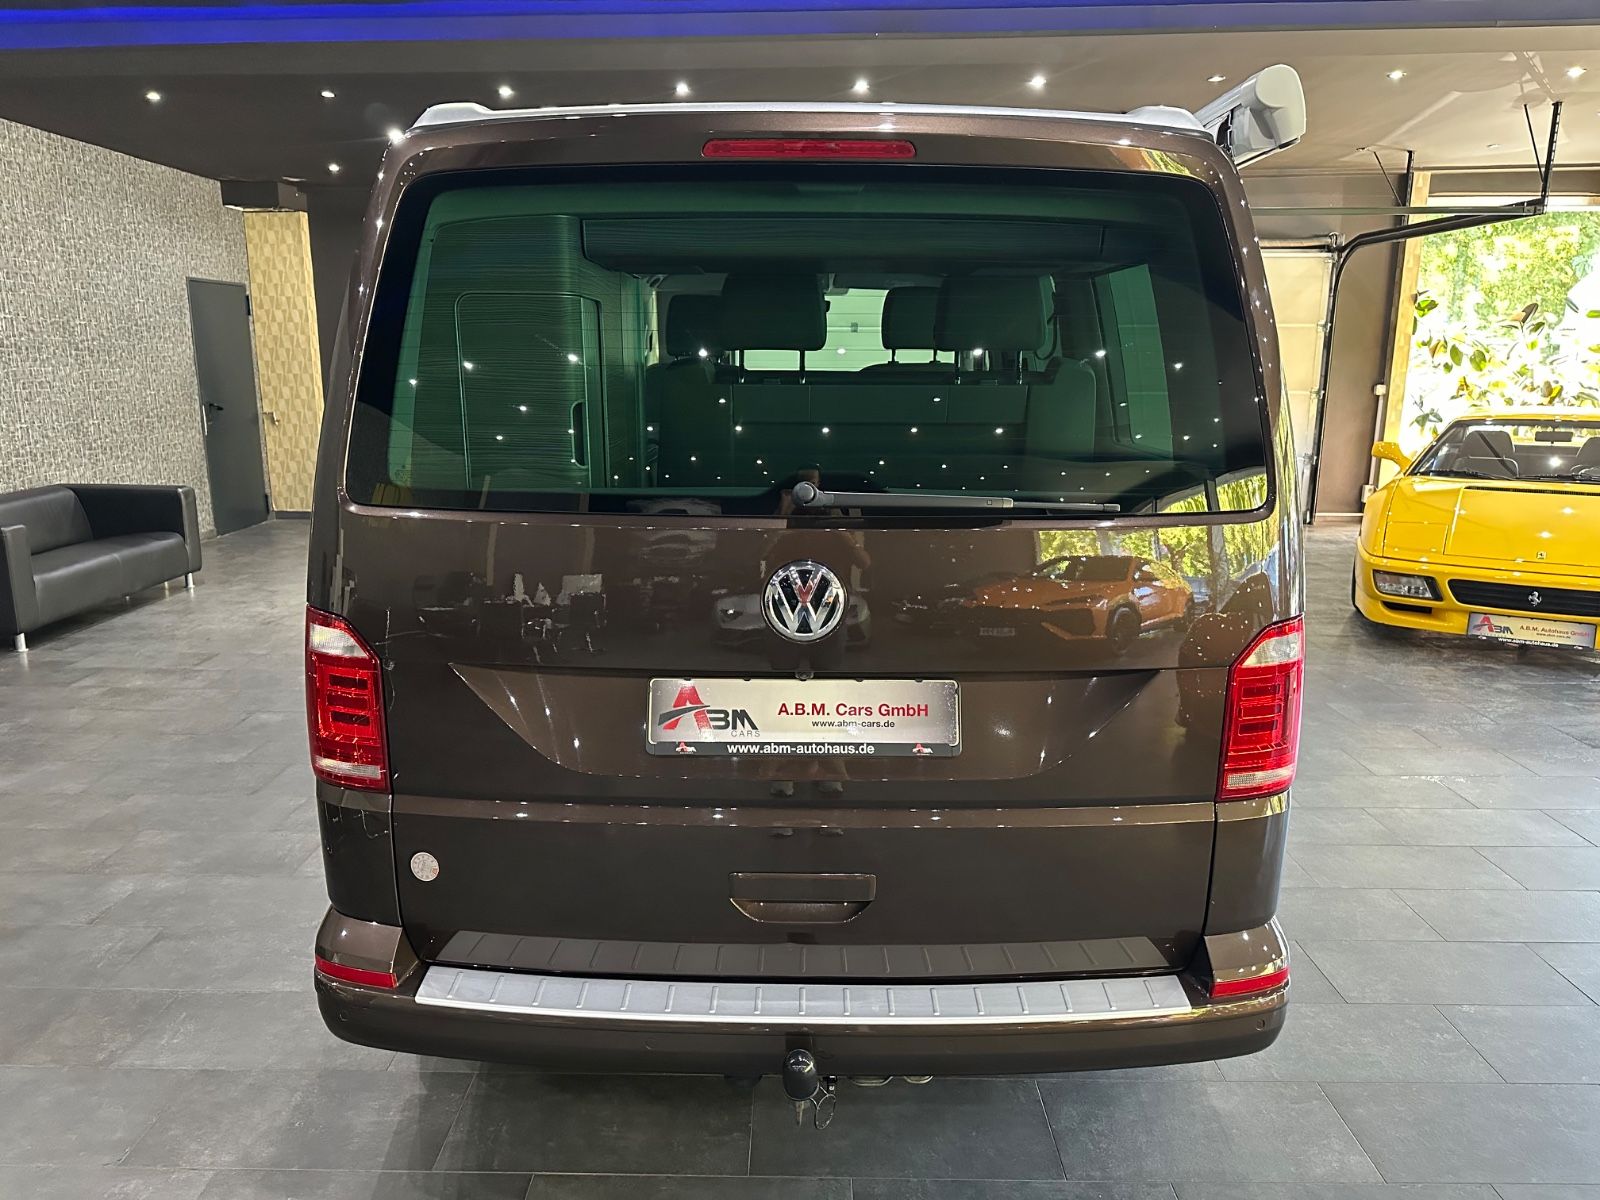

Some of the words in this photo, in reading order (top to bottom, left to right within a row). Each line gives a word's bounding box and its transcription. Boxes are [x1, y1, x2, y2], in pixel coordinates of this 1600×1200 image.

[1541, 627, 1569, 635] Autohaus
[658, 685, 758, 730] ABM
[777, 702, 830, 716] A.B.M.
[835, 703, 873, 716] Cars
[878, 703, 929, 717] GmbH
[811, 719, 895, 728] www.abm-cars.de
[731, 729, 761, 738] CARS
[727, 743, 875, 754] www.abm-autohaus.de
